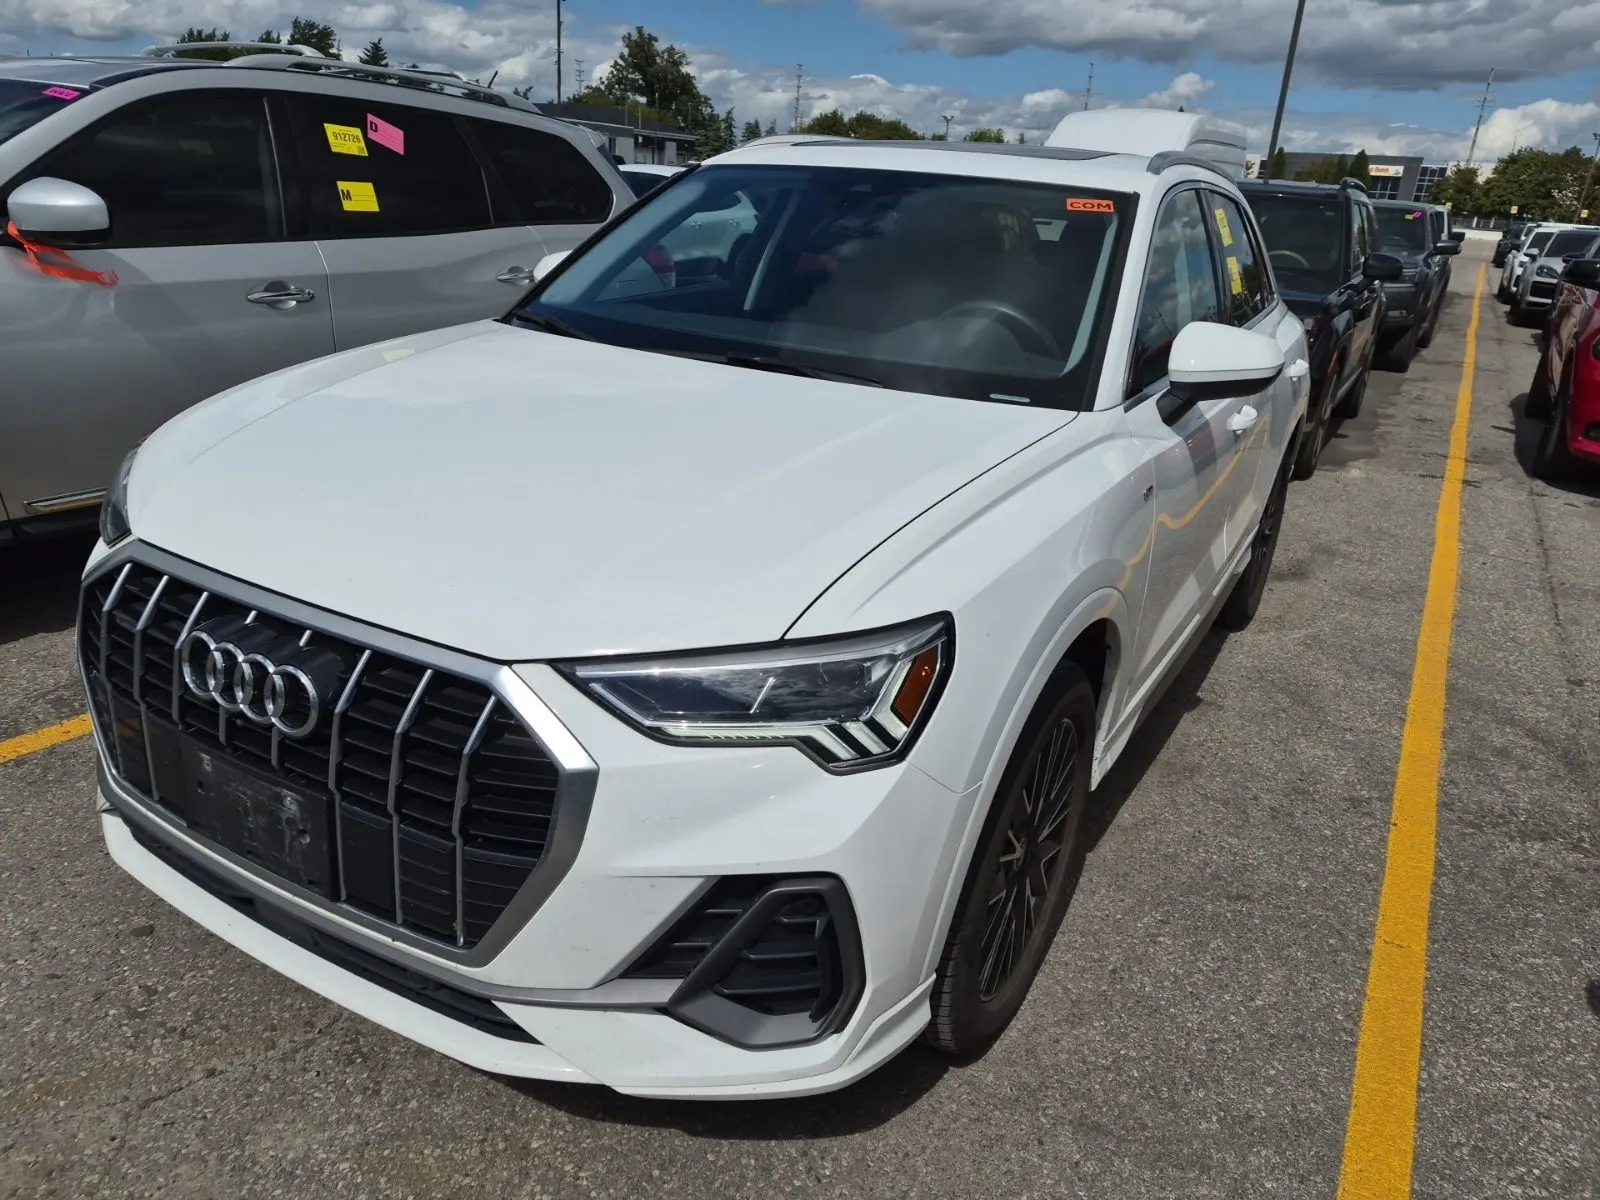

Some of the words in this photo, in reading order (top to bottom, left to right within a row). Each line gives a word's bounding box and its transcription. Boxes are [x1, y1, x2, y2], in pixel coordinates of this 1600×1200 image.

[369, 120, 378, 133] D
[340, 189, 352, 201] M
[1069, 201, 1112, 210] COM
